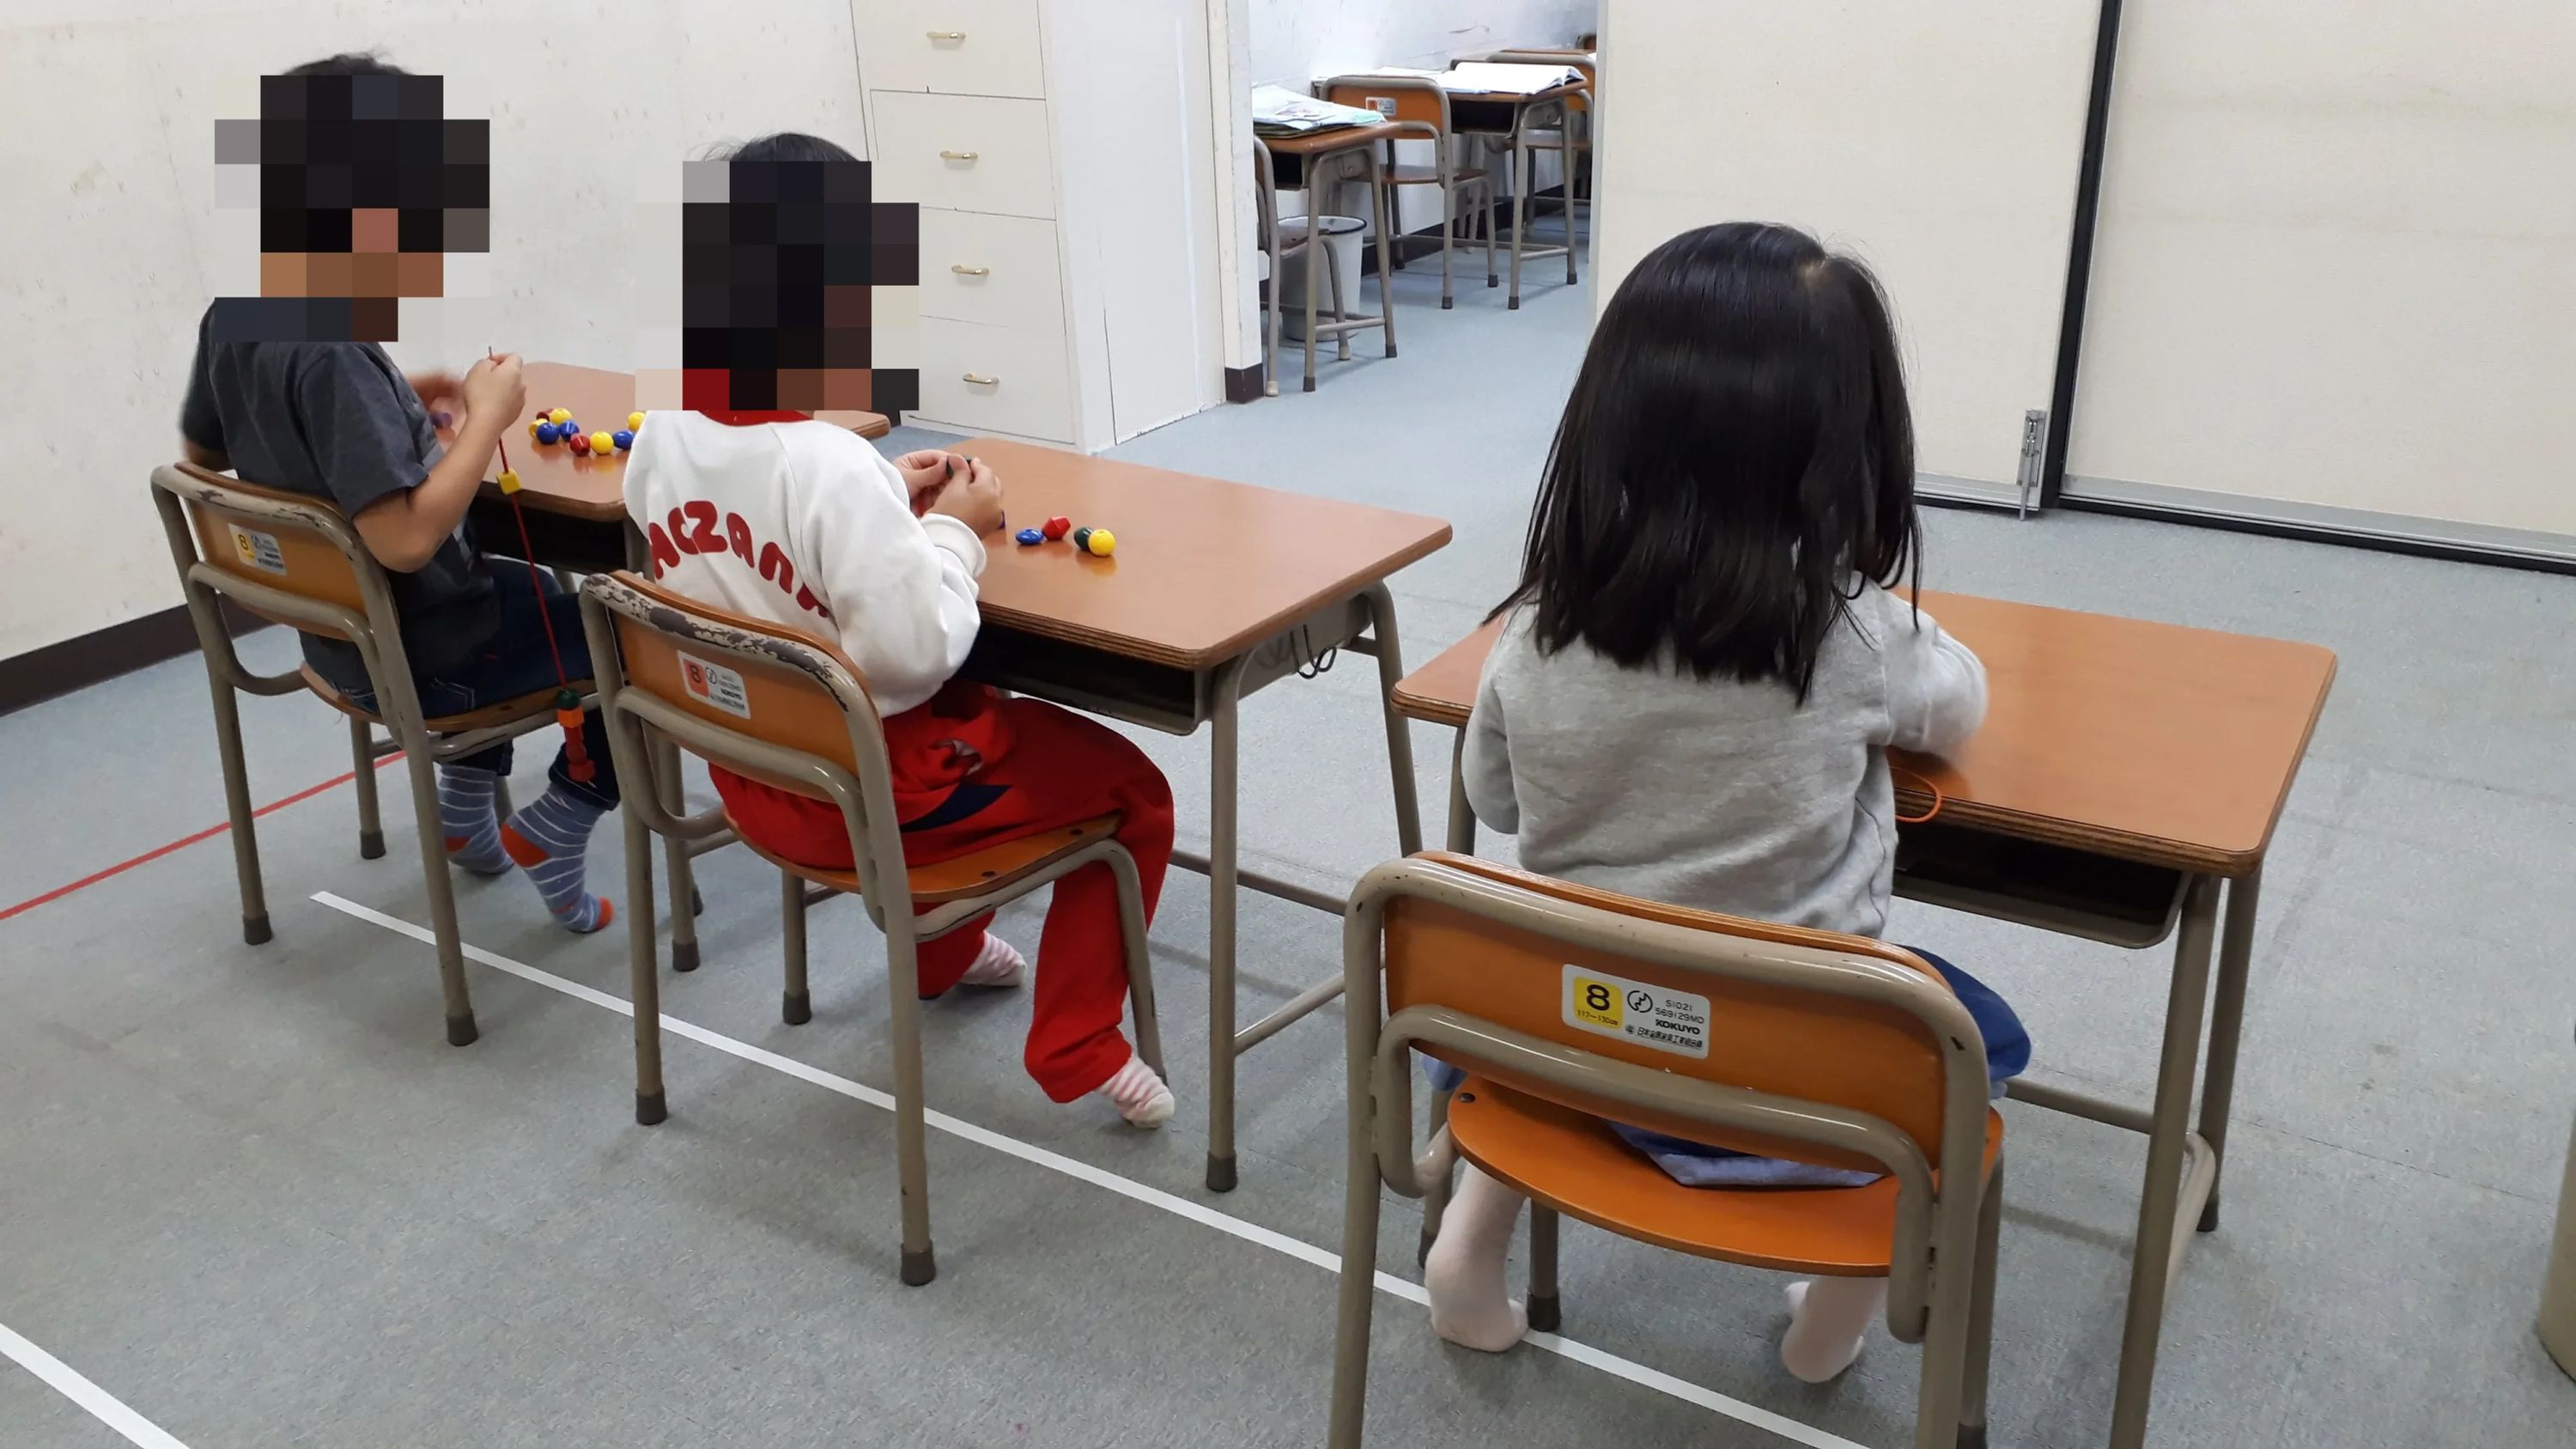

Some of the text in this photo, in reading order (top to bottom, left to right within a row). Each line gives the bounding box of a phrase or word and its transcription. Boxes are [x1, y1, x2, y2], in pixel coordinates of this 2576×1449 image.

[238, 534, 249, 551] 8
[690, 665, 702, 684] 8
[1586, 983, 1611, 1012] 8
[1655, 1018, 1701, 1035] KOKUYO
